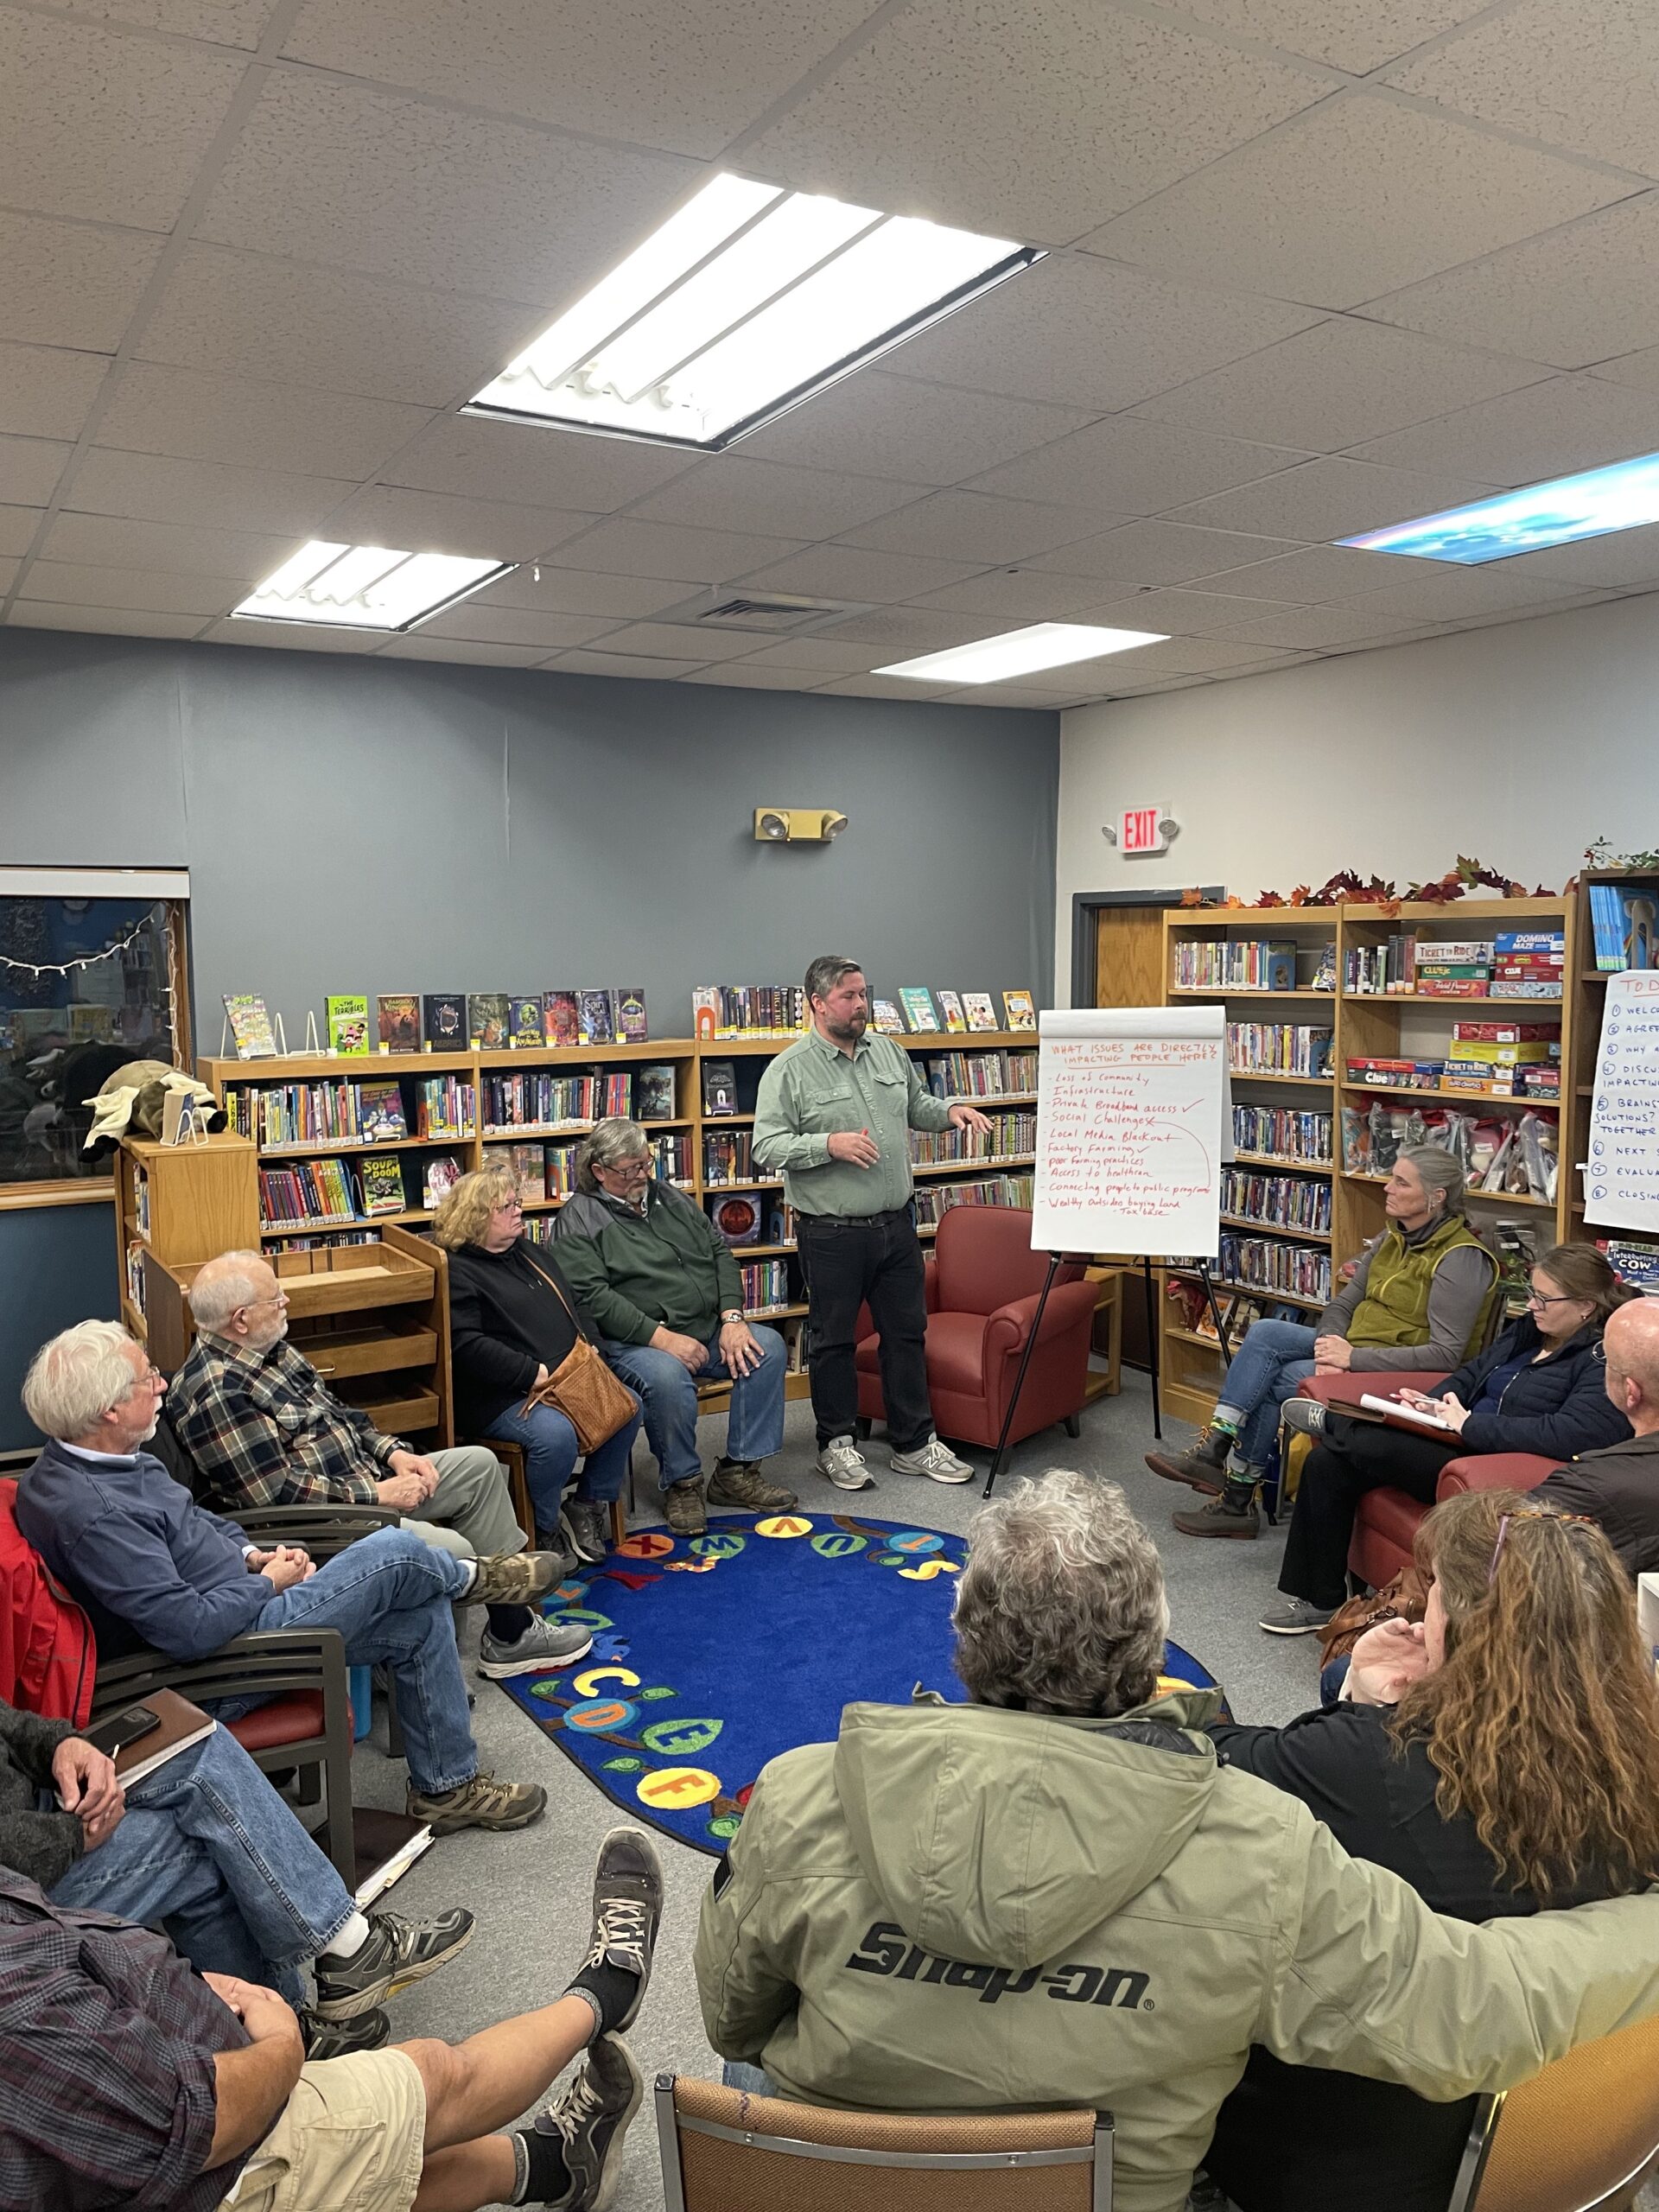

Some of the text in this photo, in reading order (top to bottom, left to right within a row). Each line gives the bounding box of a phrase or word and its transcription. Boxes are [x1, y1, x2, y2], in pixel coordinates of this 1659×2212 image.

[1125, 810, 1156, 849] EXIT
[1516, 934, 1554, 943] DOMINO
[1420, 946, 1446, 957] TICKET
[1453, 945, 1471, 956] RIDE
[334, 1004, 364, 1015] TERRIBLES
[1051, 1043, 1217, 1054] WHAT ISSUES ARE DIRECTLY
[1624, 1046, 1646, 1055] WHY
[1064, 1051, 1217, 1064] IMPACTING PEOPLE HERE?
[1055, 1072, 1075, 1083] Loss
[1082, 1073, 1093, 1082] of
[1365, 1071, 1389, 1084] Clue
[1052, 1111, 1087, 1122] Social
[1593, 1112, 1656, 1123] SOLUTIONS?
[1050, 1126, 1078, 1139] Local
[1616, 1147, 1647, 1156] NEXT
[363, 1160, 392, 1174] SOUP
[372, 1163, 401, 1179] DOOM
[1085, 1166, 1100, 1179] to
[1618, 1259, 1651, 1270] COW
[624, 1535, 668, 1555] X
[572, 1667, 641, 1698] C
[570, 1702, 626, 1727] D
[654, 1722, 712, 1748] E
[642, 1773, 708, 1797] F
